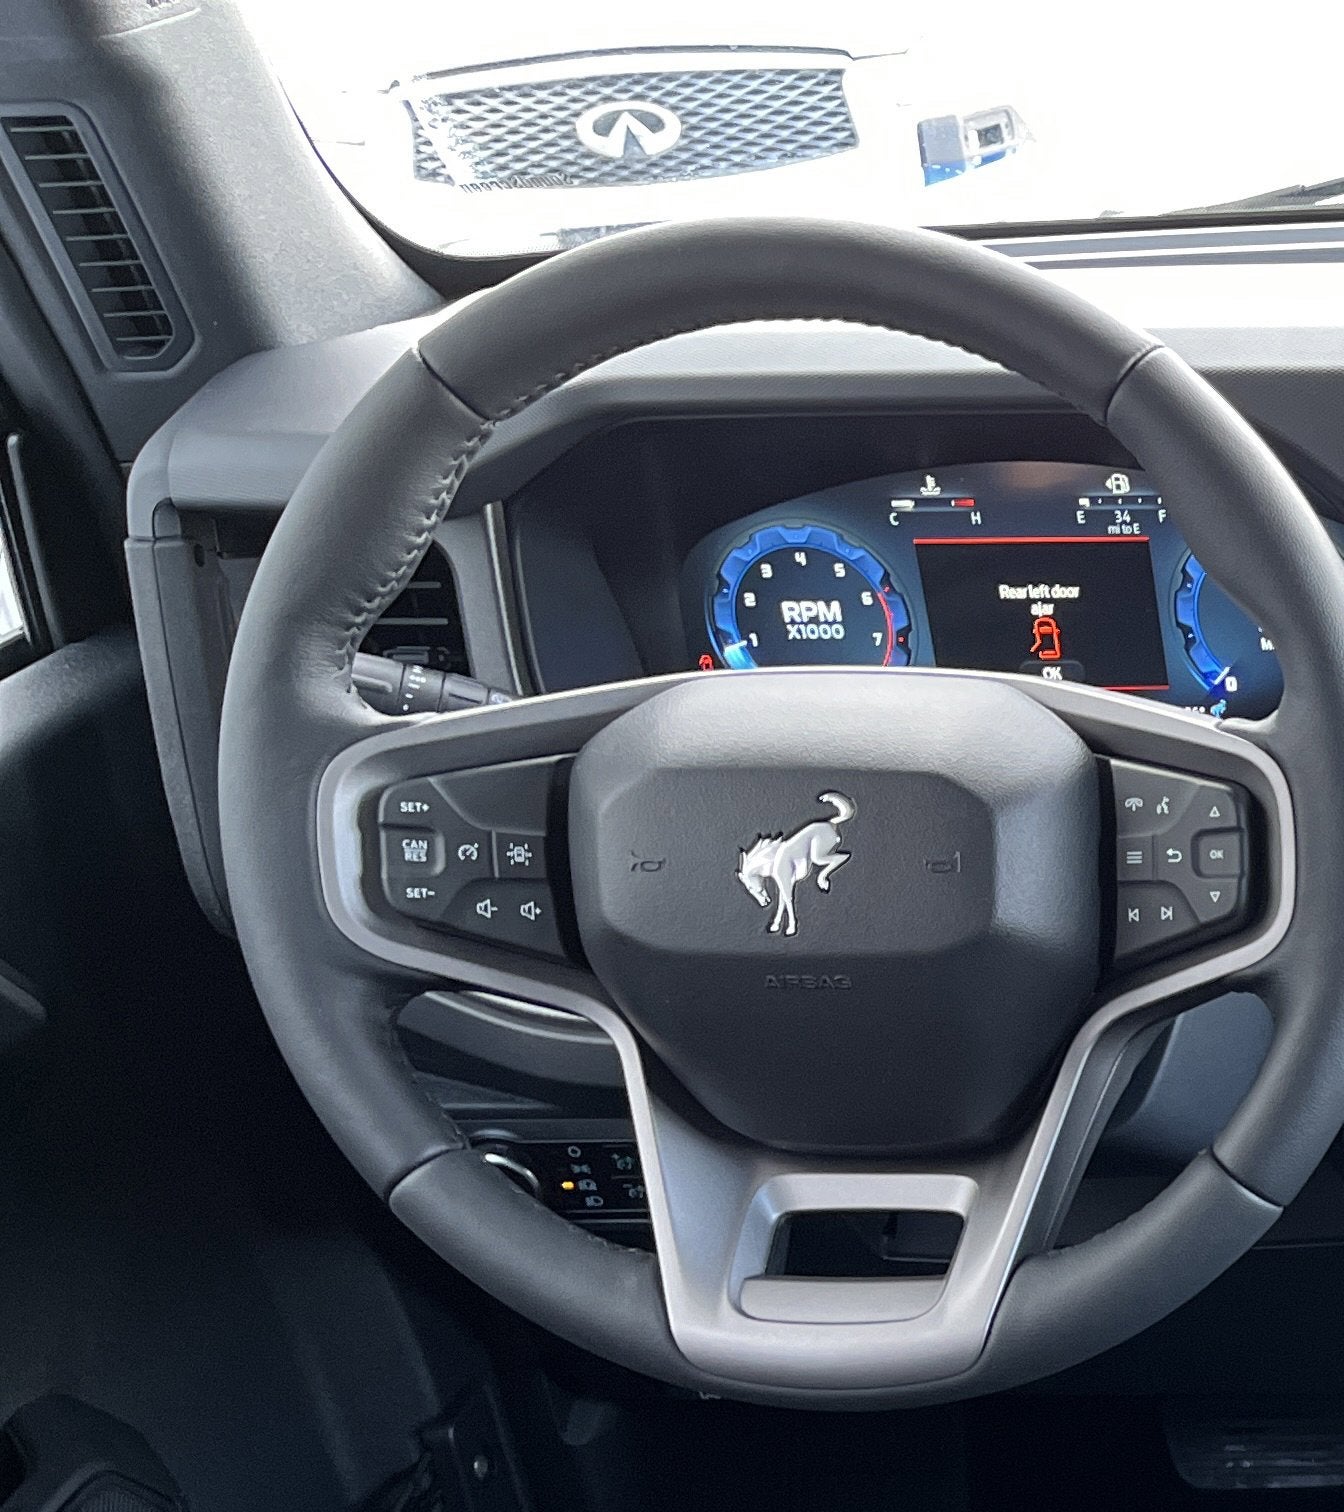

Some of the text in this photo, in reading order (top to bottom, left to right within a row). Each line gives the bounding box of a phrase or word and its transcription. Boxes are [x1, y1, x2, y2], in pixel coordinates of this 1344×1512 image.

[889, 511, 981, 526] C H
[1077, 510, 1167, 524] E 34 F
[1108, 524, 1140, 534] mi to E
[795, 552, 807, 567] 4
[760, 563, 772, 578] 3
[834, 563, 845, 577] 5
[861, 591, 873, 605] 6
[999, 584, 1079, 599] Rear left door
[744, 592, 756, 607] 2
[781, 600, 843, 623] RPM
[1030, 602, 1054, 617] ajar
[786, 624, 844, 640] X1000
[872, 632, 882, 646] 7
[749, 633, 758, 647] 1
[1043, 667, 1062, 680] OK
[1225, 676, 1237, 692] 0
[400, 802, 430, 813] SET+
[402, 839, 427, 849] CAN
[404, 851, 427, 862] RES
[1209, 850, 1224, 859] OK
[406, 888, 435, 898] SET-
[764, 974, 852, 990] AIRBAG
